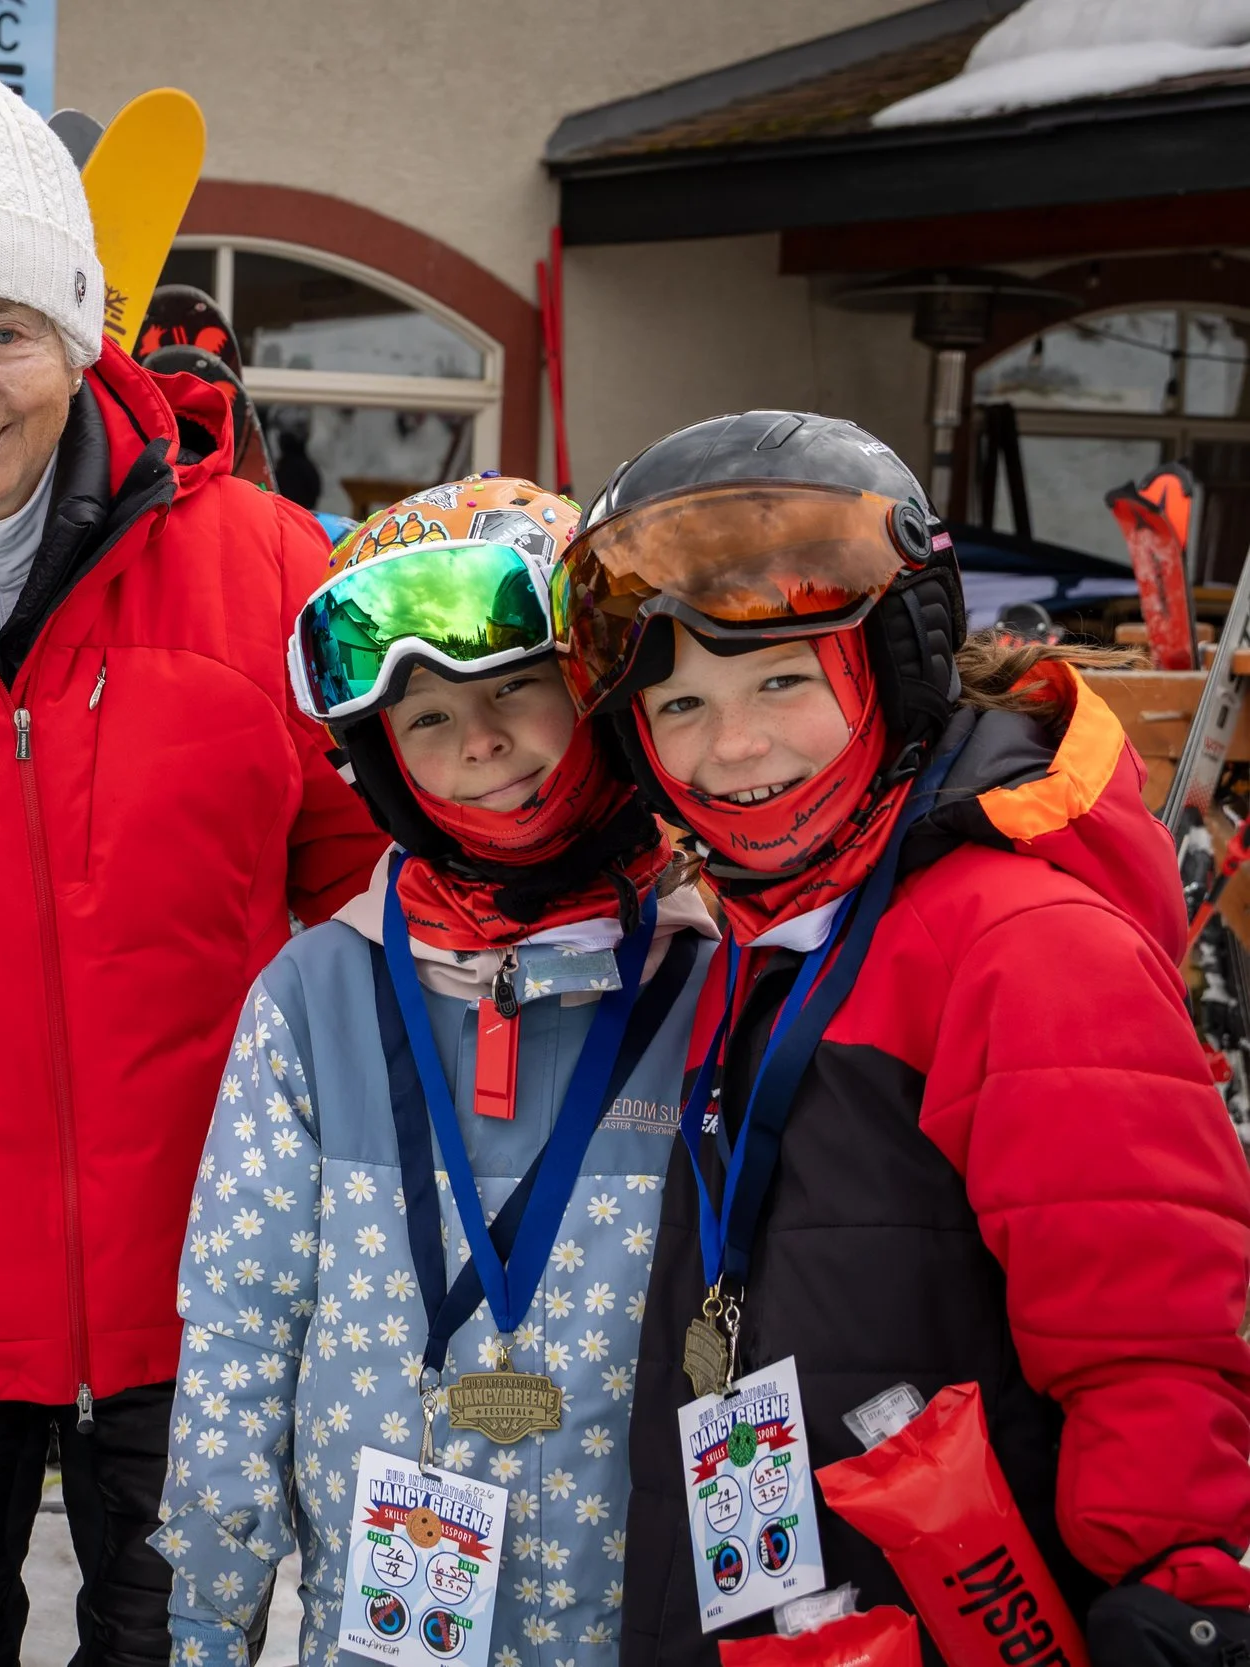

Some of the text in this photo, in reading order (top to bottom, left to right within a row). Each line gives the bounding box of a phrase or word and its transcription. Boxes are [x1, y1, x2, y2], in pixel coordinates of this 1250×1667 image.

[465, 1379, 547, 1391] HUB INTERNATIONAL
[453, 1388, 556, 1408] NANCY GREENE
[484, 1407, 527, 1417] FESTIVAL
[690, 1393, 790, 1458] NANCY GREENE
[705, 1446, 726, 1465] SKILLS
[385, 1468, 484, 1511] HUB INTERNATIONAL
[464, 1483, 495, 1500] 2026
[369, 1479, 494, 1537] NANCY GREENE
[384, 1508, 410, 1523] SKILLS
[718, 1577, 736, 1588] HUB
